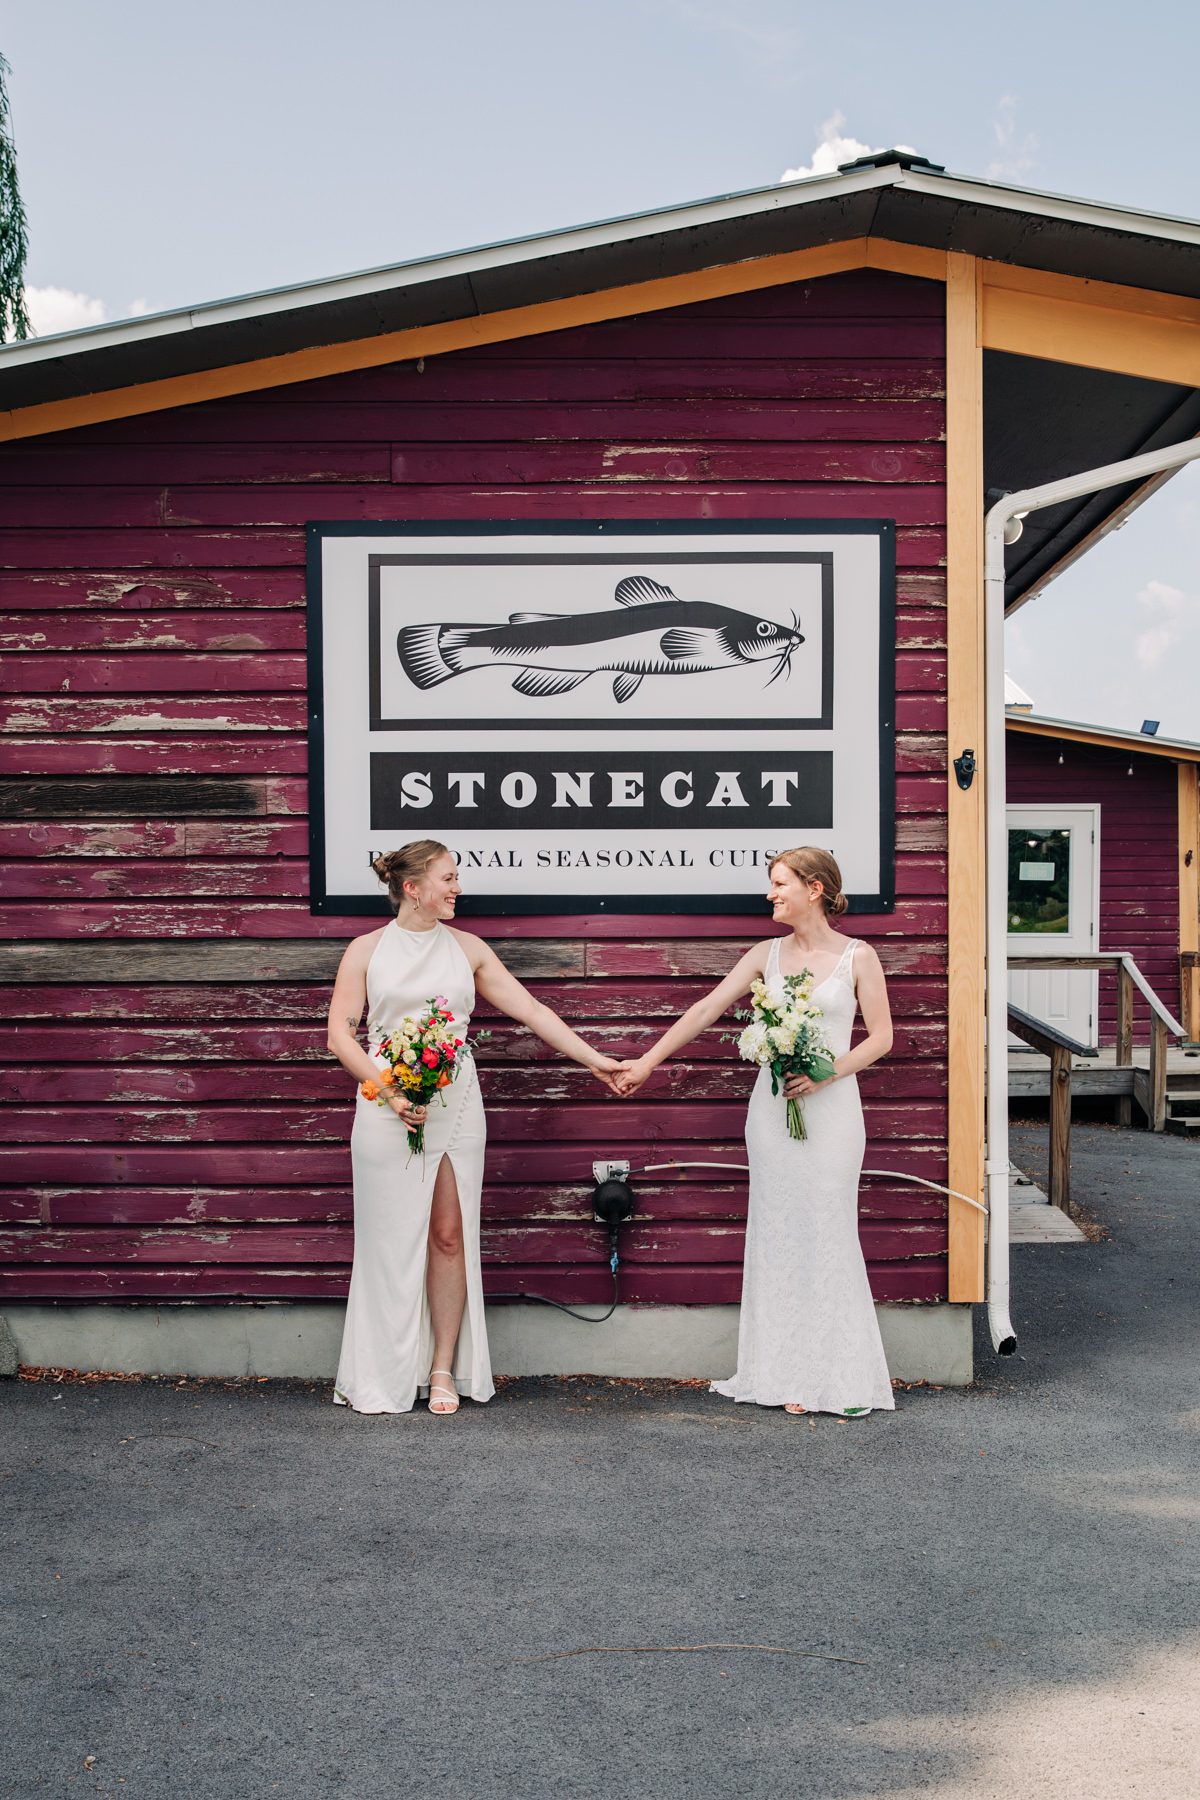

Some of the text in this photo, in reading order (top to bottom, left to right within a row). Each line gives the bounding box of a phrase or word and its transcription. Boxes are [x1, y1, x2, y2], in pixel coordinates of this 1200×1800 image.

[400, 771, 799, 809] STONECAT
[536, 849, 694, 868] SEASONAL
[708, 849, 834, 868] CUIS
